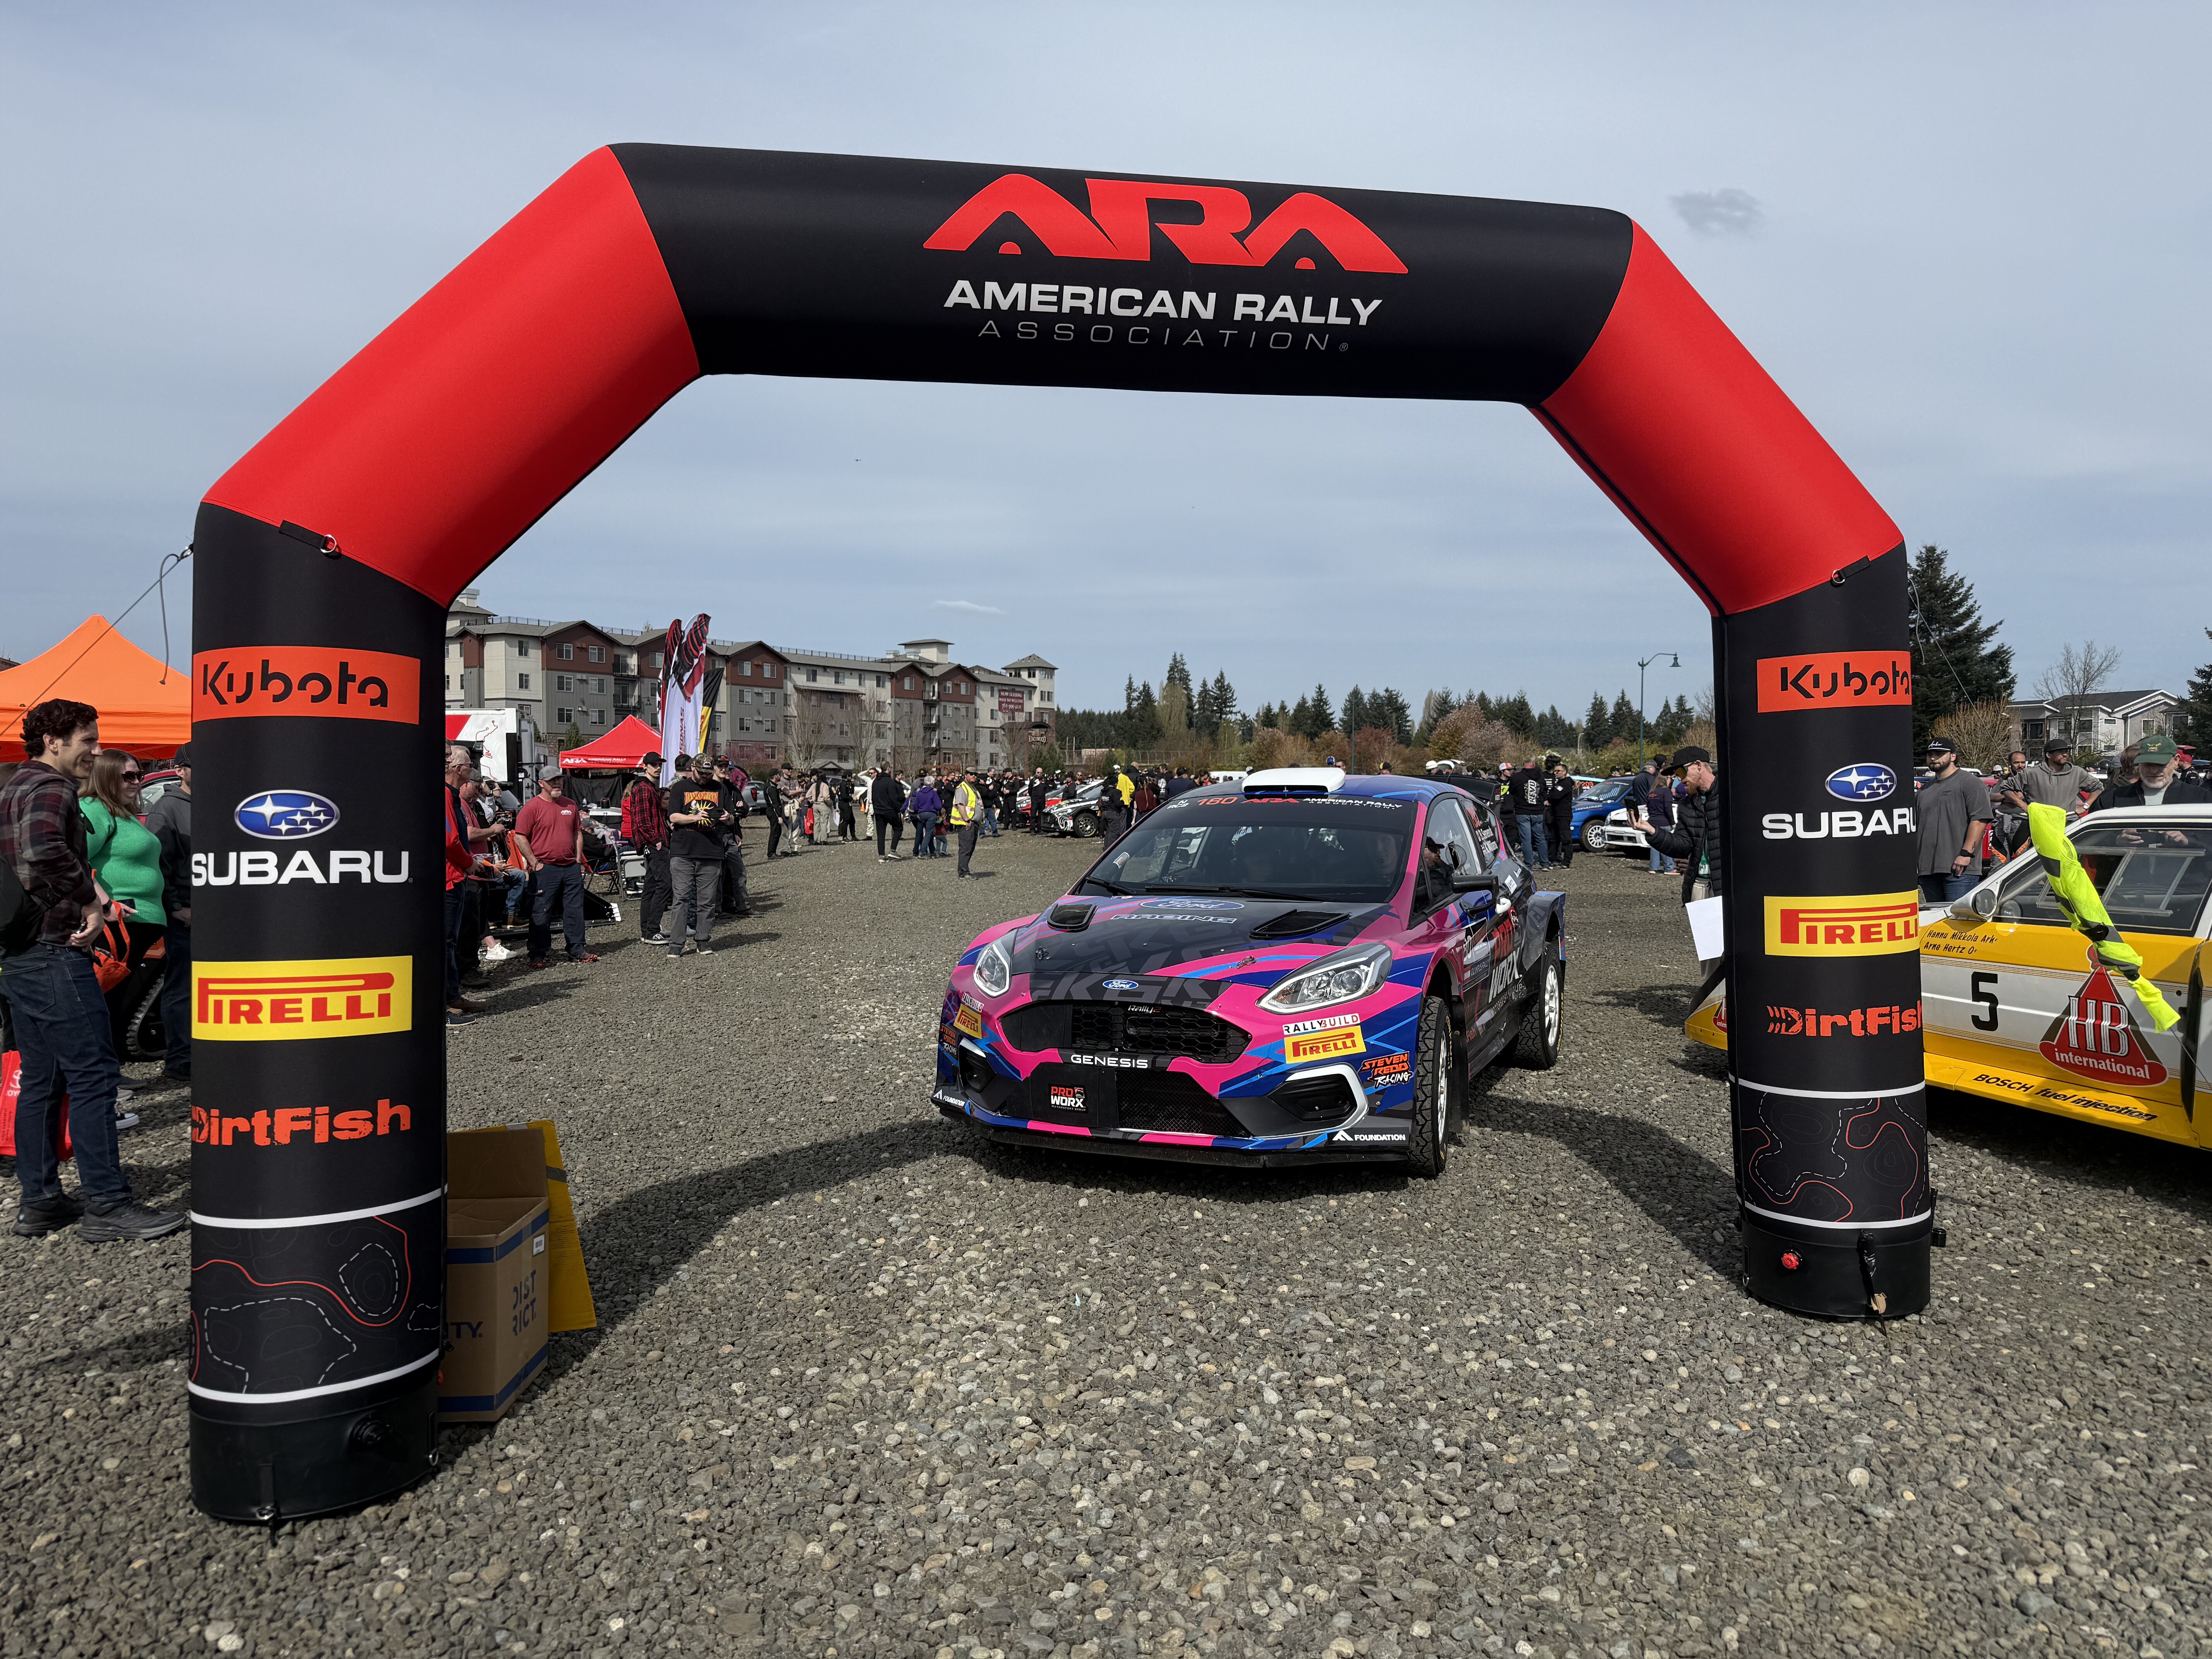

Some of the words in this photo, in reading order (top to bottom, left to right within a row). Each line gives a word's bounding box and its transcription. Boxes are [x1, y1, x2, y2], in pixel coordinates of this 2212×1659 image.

[923, 173, 1408, 274] ARA
[943, 280, 1216, 319] AMERICAN
[1233, 294, 1383, 326] RALLY
[977, 320, 1329, 350] ASSOCIATION
[203, 659, 388, 708] Kubota
[1780, 661, 1910, 699] Kubota
[1197, 797, 1238, 805] 180
[1762, 807, 1916, 840] SUBARU
[191, 850, 409, 886] SUBARU
[1157, 899, 1225, 909] Ford
[1110, 914, 1237, 924] RACING
[1780, 902, 1918, 944] PIRELLI
[1492, 919, 1513, 966] PRO
[1923, 941, 1941, 950] Arne
[1943, 943, 1966, 953] Hertz
[1927, 929, 1949, 939] Hannu
[1950, 931, 1978, 942] Mikkola
[1108, 980, 1132, 988] Ford
[198, 972, 395, 1024] PIRELLI
[1128, 1005, 1162, 1013] Rally2
[1971, 971, 1999, 1032] 5
[940, 1024, 956, 1039] STEVEN
[957, 1009, 979, 1033] PIRELLI
[2068, 995, 2130, 1057] HB
[1292, 1032, 1357, 1058] PIRELLI
[1071, 1054, 1148, 1069] GENESIS
[1362, 1054, 1408, 1070] STEVEN
[1373, 1062, 1409, 1076] REDD
[2054, 1049, 2150, 1080] international
[1051, 1086, 1073, 1097] PRO
[1372, 1072, 1412, 1088] RACING
[943, 1095, 965, 1107] FOUNDATION
[1973, 1074, 2035, 1092] BOSCH
[2034, 1089, 2072, 1103] fuel
[2070, 1097, 2159, 1121] injection
[1354, 1133, 1406, 1142] FOUNDATION
